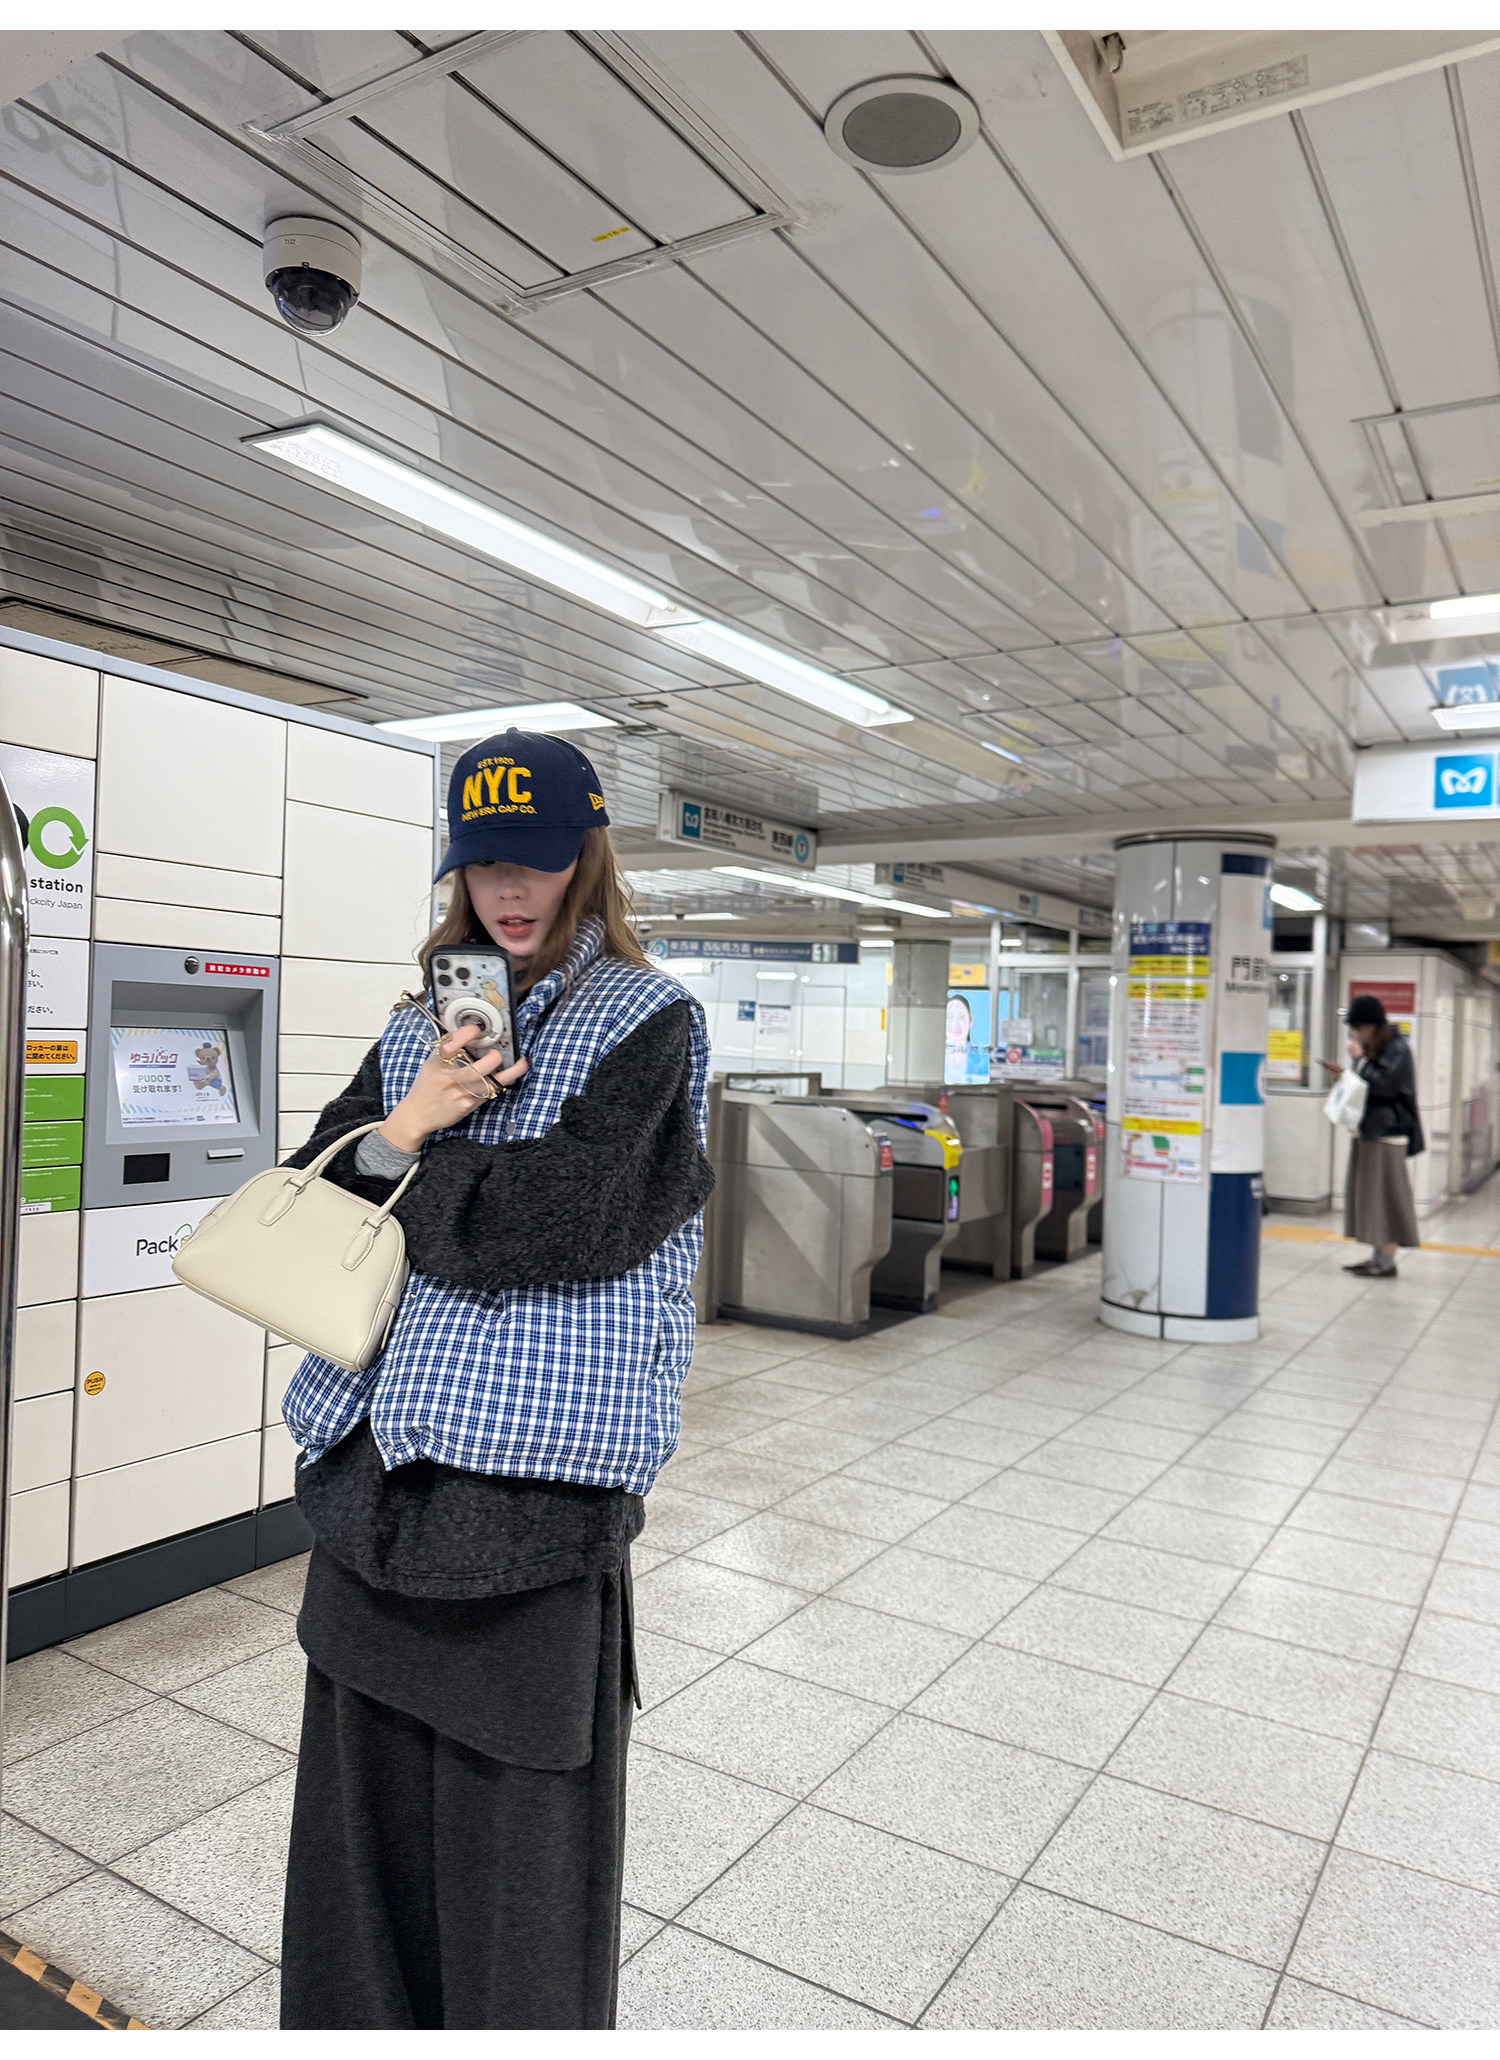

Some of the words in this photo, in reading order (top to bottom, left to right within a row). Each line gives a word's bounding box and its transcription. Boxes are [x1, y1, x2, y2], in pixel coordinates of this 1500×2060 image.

[463, 766, 532, 810] NYC
[461, 810, 479, 822] NEW
[478, 806, 497, 816] ERA
[497, 804, 518, 813] CAP
[519, 804, 538, 814] CO.
[30, 877, 83, 893] station
[57, 900, 83, 910] Japan
[129, 1047, 178, 1064] ゆうパック
